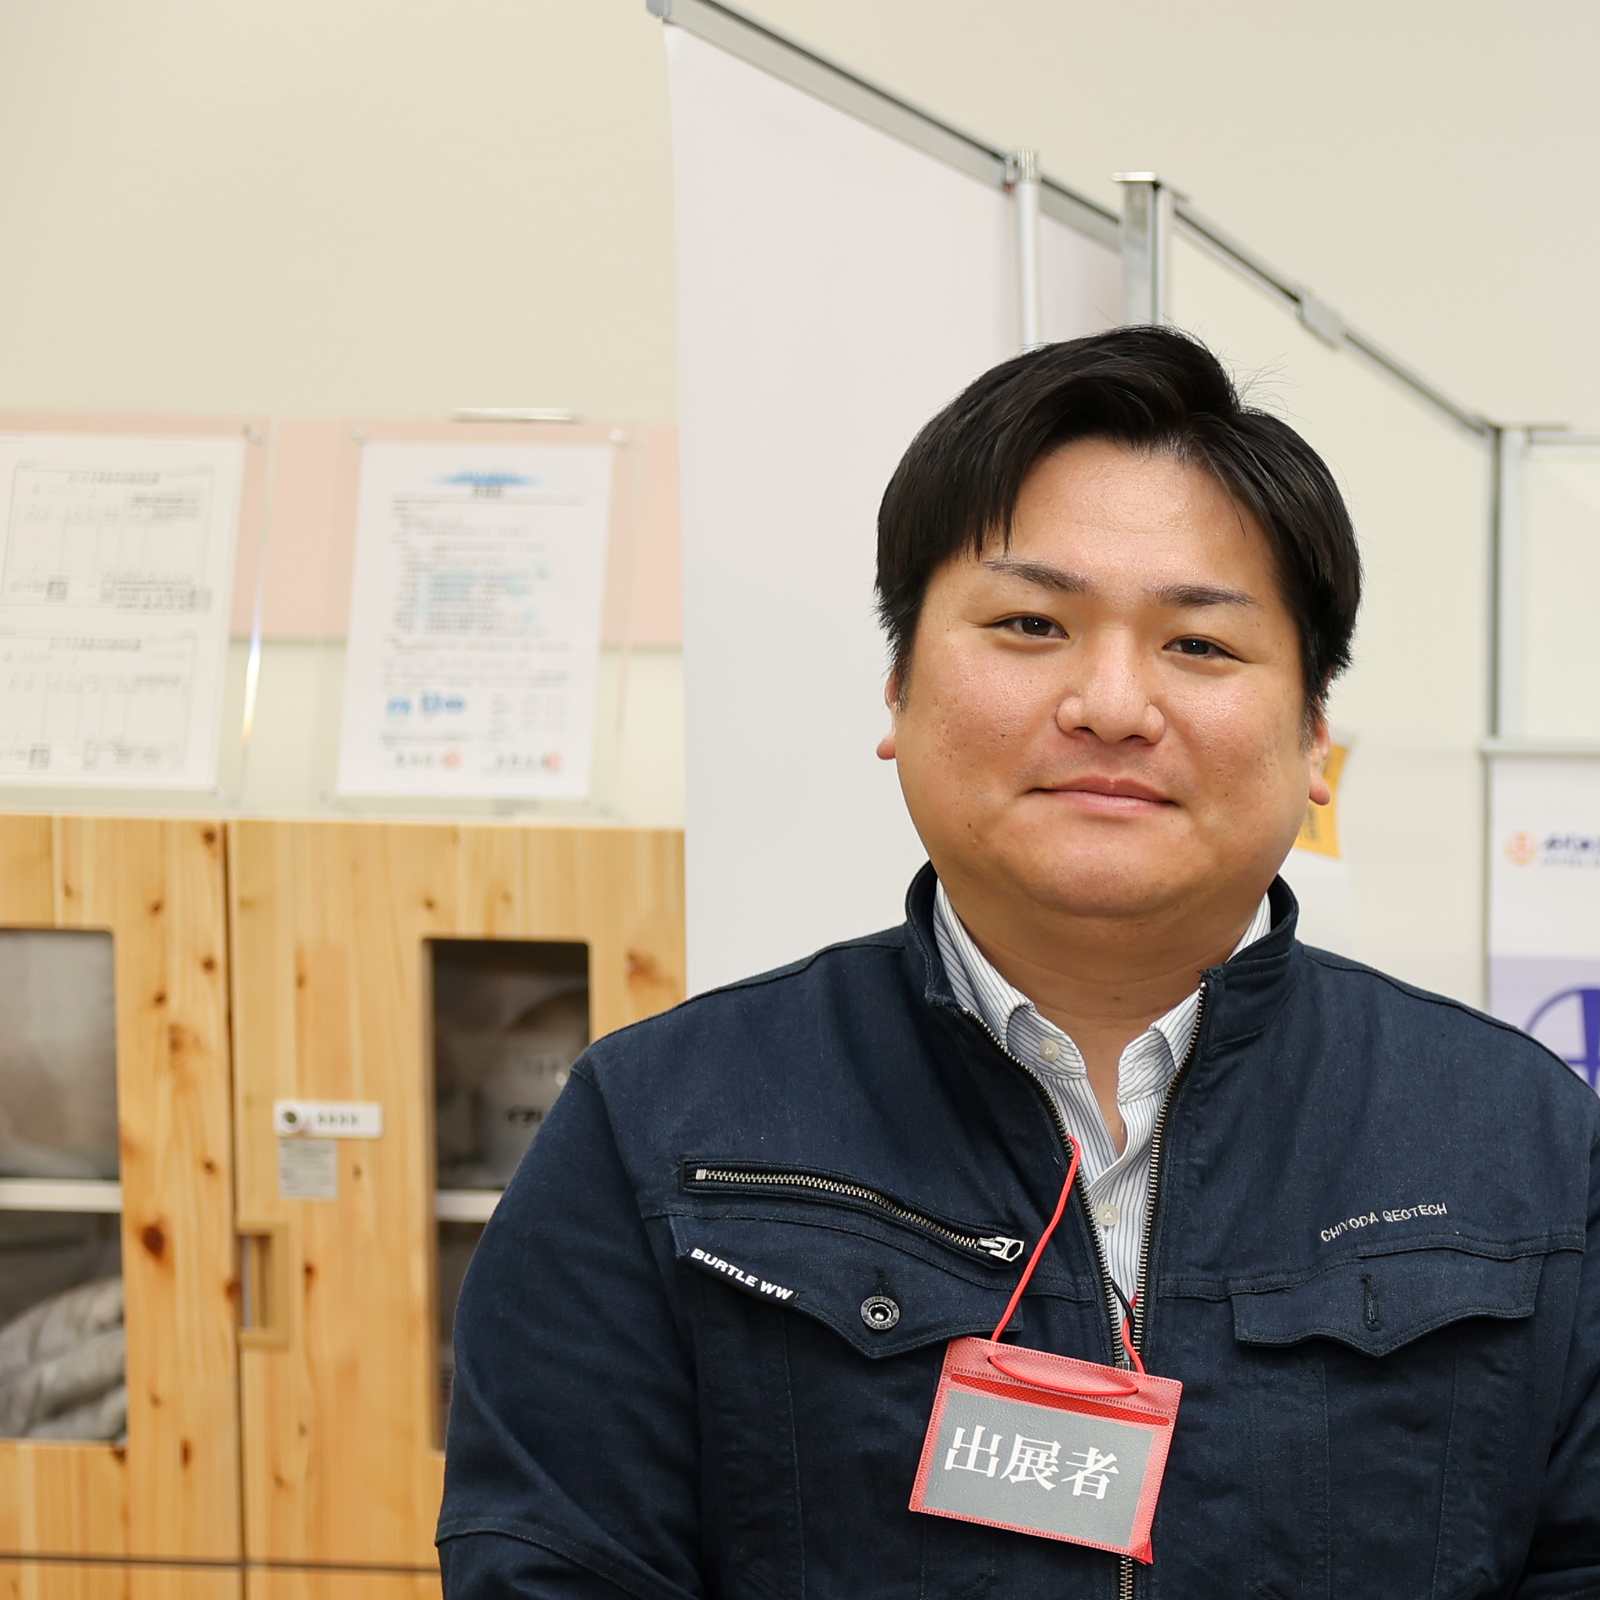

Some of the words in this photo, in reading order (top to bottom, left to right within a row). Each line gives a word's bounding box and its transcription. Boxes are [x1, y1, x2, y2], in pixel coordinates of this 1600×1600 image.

[1320, 1211, 1379, 1242] CHIYODA
[1382, 1202, 1448, 1223] GEOTECH
[690, 1248, 756, 1288] BURTLE
[760, 1280, 794, 1301] WW
[944, 1425, 1120, 1500] 出展者
